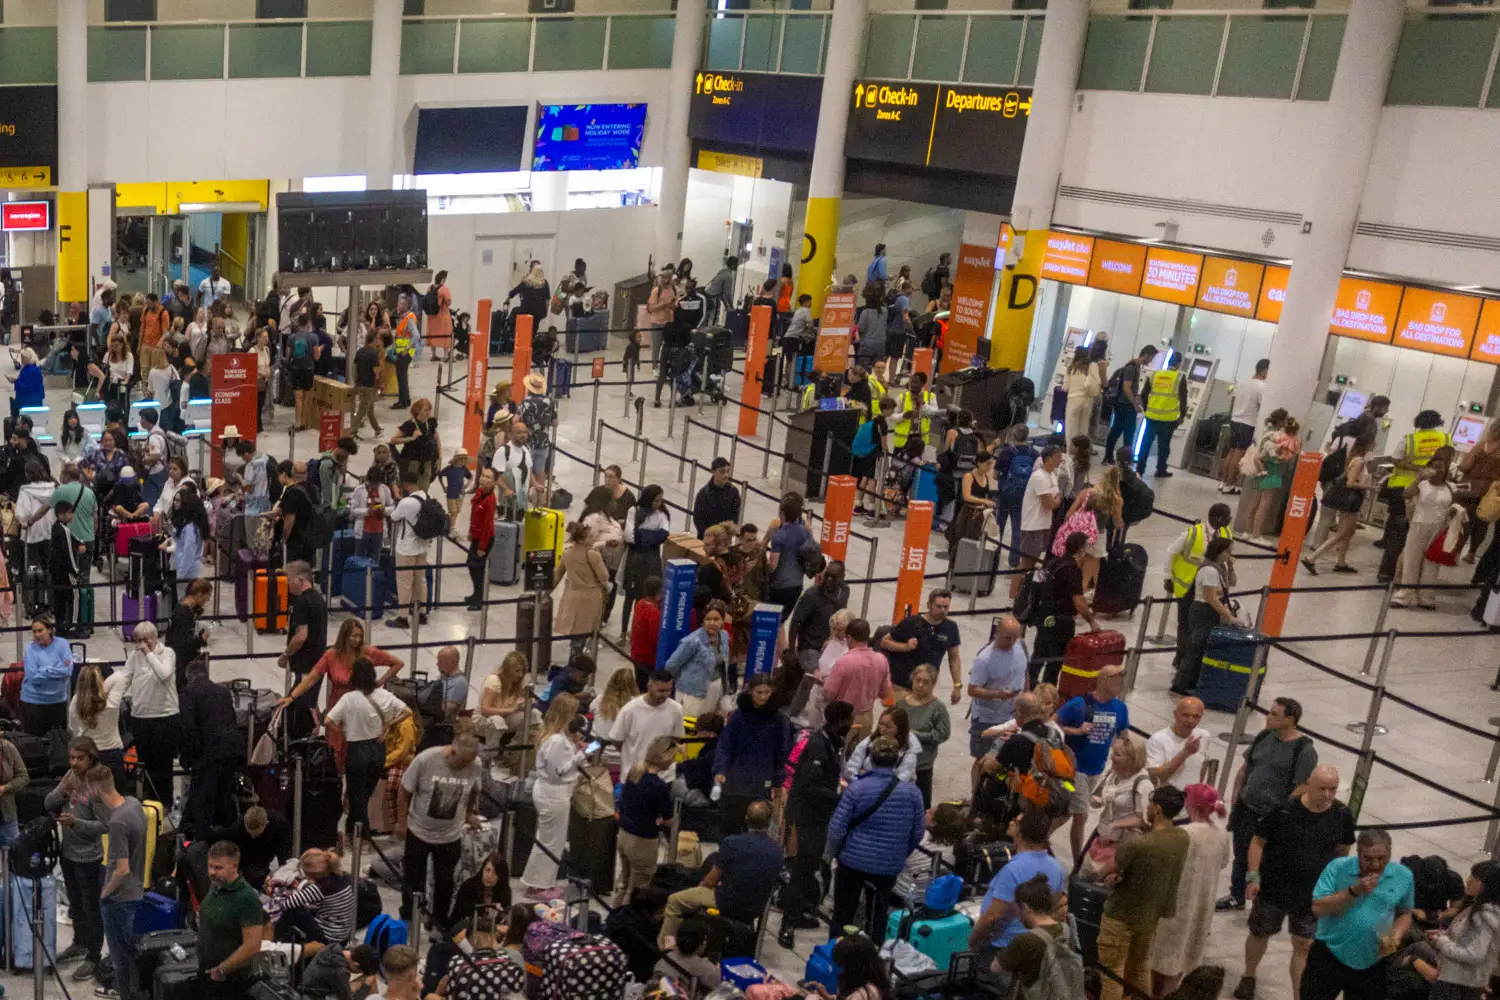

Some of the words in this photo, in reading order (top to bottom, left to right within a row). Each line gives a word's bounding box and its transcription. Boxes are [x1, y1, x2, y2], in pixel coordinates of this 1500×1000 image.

[714, 76, 743, 92] Check-in
[879, 86, 918, 105] Check-in
[946, 90, 1002, 112] Departures
[1048, 239, 1075, 251] easyJet
[964, 256, 991, 268] easyJet
[1102, 260, 1132, 273] WELCOME
[1147, 267, 1158, 278] 30
[1160, 268, 1196, 284] MINUTES
[1008, 274, 1037, 310] D
[956, 305, 963, 313] TO
[958, 296, 984, 308] WELCOME
[1213, 296, 1251, 309] DESTINATIONS
[955, 314, 980, 328] TERMINAL
[1336, 308, 1349, 318] BAG
[1350, 310, 1370, 321] DROP
[1370, 314, 1384, 323] FOR
[1342, 318, 1387, 334] DESTINATIONS
[1408, 320, 1423, 331] BAG
[1425, 323, 1445, 334] DROP
[1446, 327, 1461, 337] FOR
[1401, 330, 1414, 340] ALL
[1414, 331, 1465, 348] DESTINATIONS
[1289, 495, 1307, 518] EXIT
[834, 521, 848, 543] EXIT
[907, 547, 924, 571] EXIT
[676, 591, 687, 631] PREMIUM
[432, 775, 468, 785] PARIS
